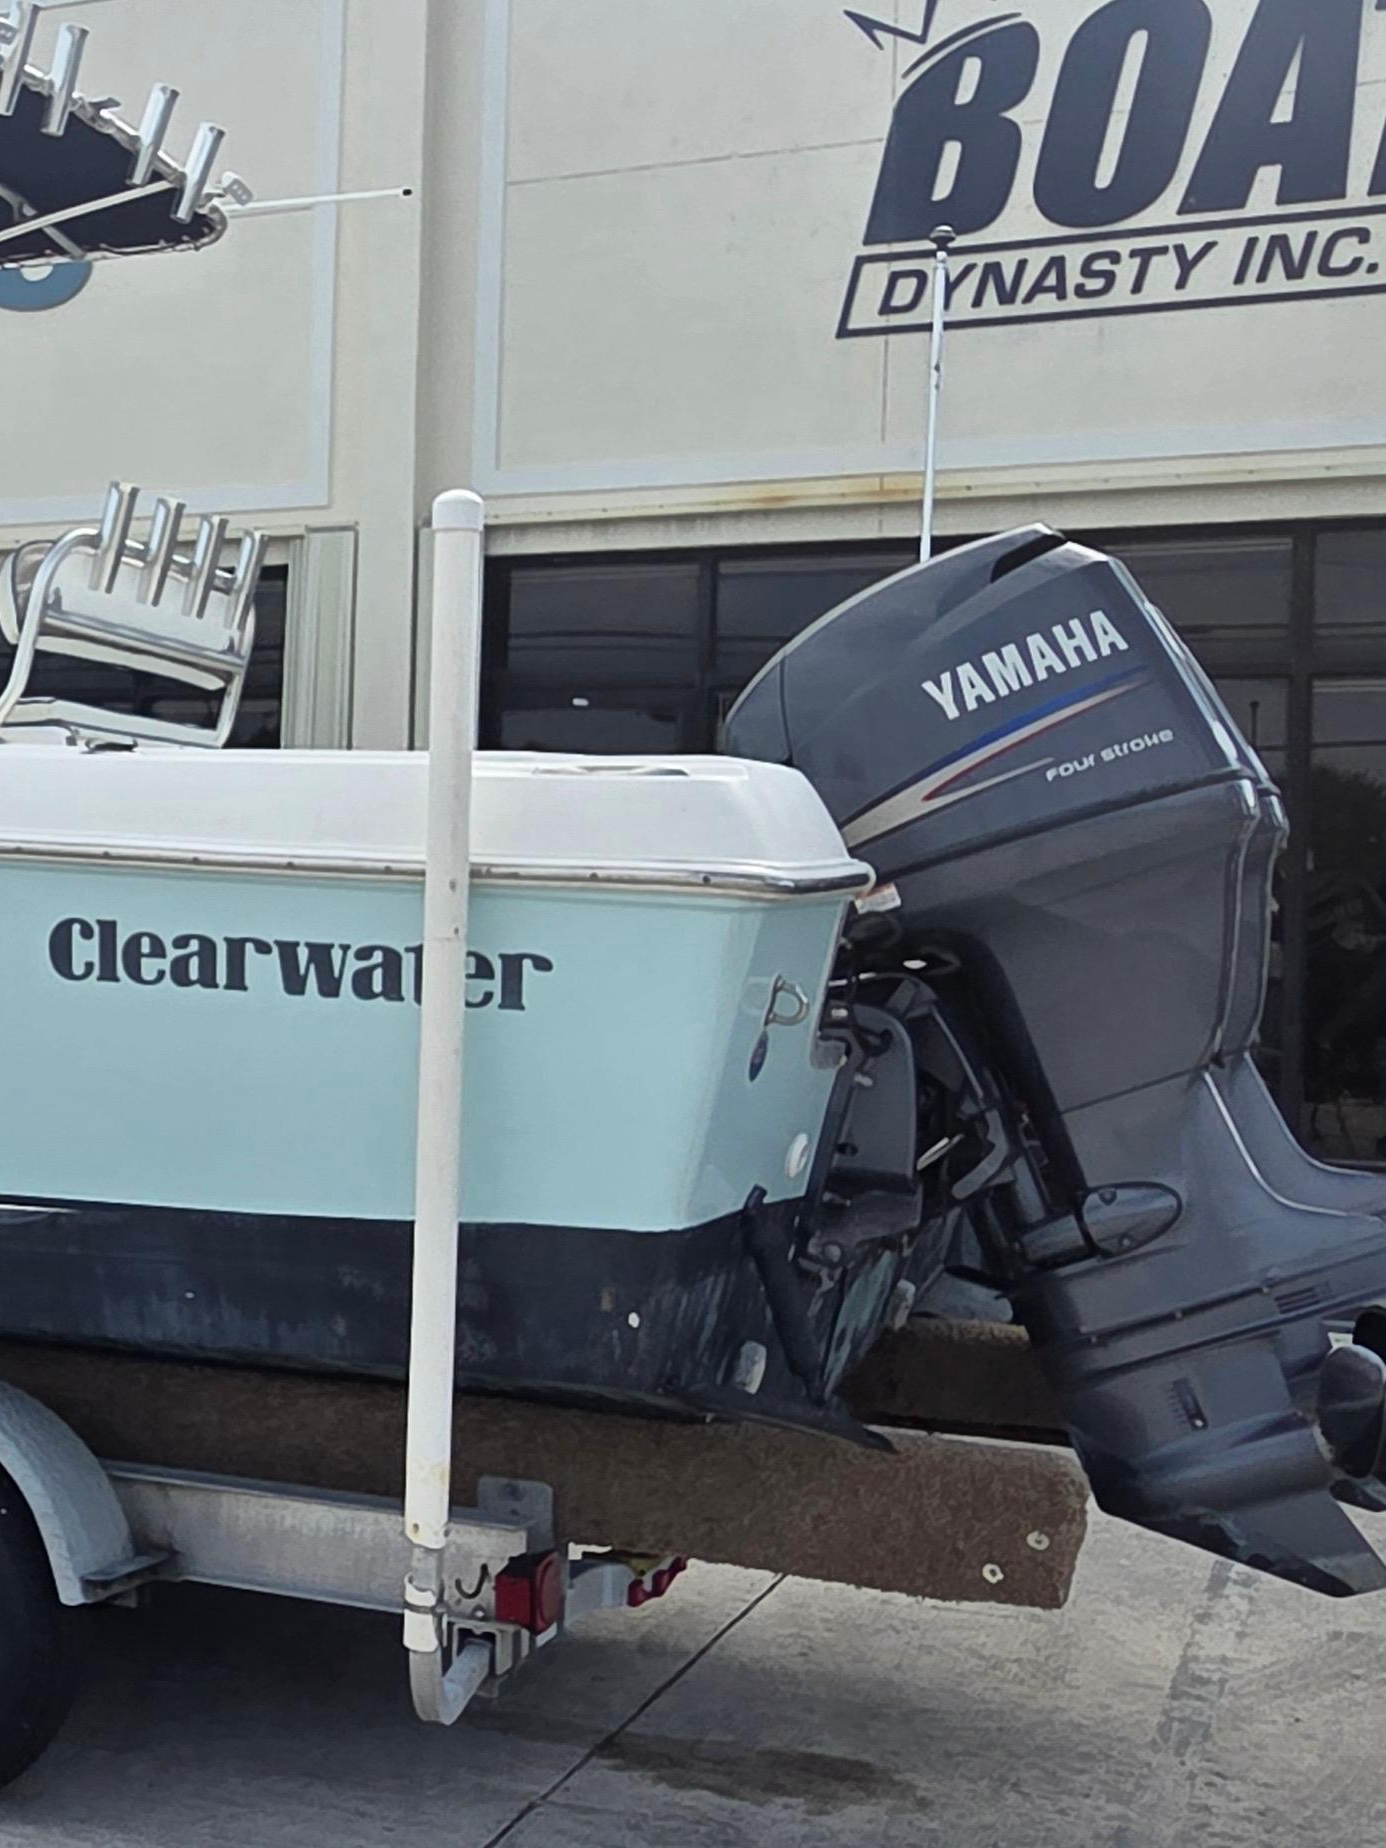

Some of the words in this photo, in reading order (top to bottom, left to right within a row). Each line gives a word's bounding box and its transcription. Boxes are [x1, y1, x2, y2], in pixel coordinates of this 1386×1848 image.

[863, 0, 1386, 246] BOA
[878, 241, 1218, 316] DYNASTY
[1233, 227, 1380, 286] INC.
[921, 610, 1129, 721] YAMAHA
